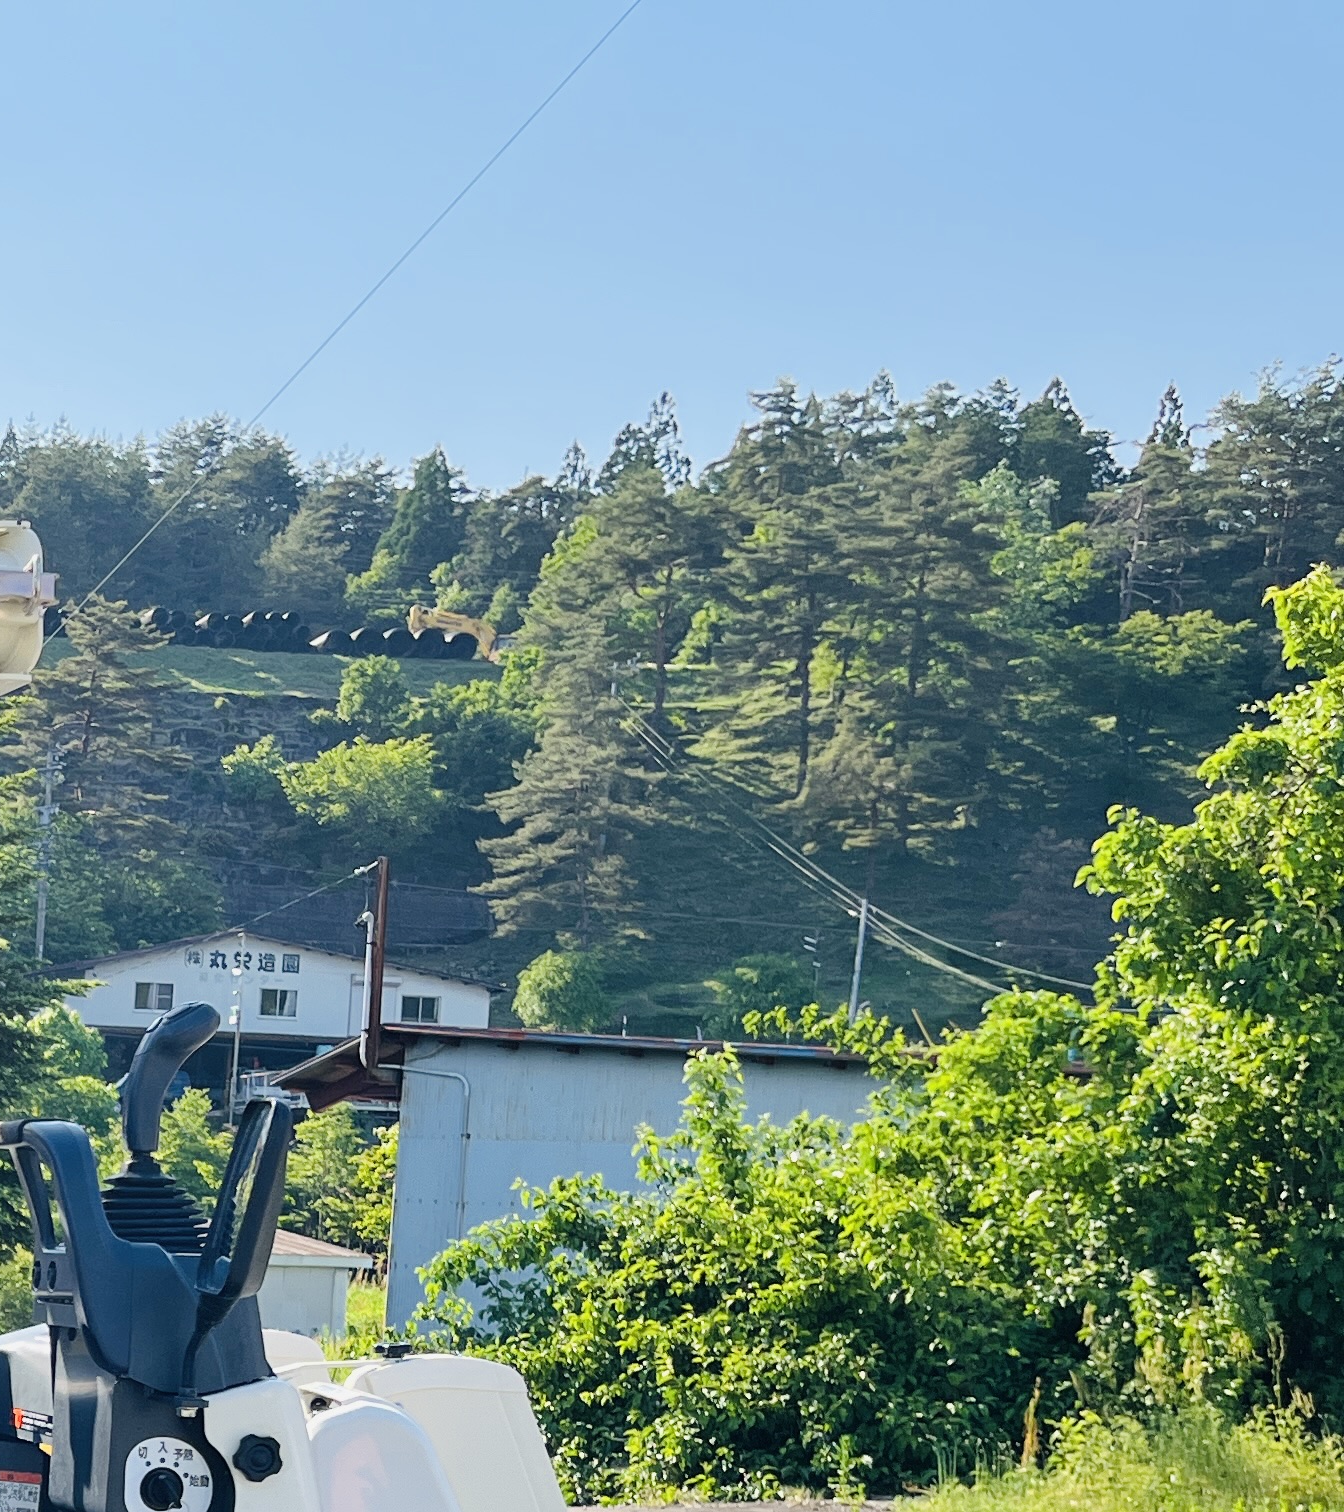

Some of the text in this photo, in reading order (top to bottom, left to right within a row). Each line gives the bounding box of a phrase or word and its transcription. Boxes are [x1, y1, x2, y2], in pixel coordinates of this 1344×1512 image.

[138, 1446, 148, 1459] 切
[157, 1441, 168, 1453] 入
[188, 1474, 209, 1488] 始動
